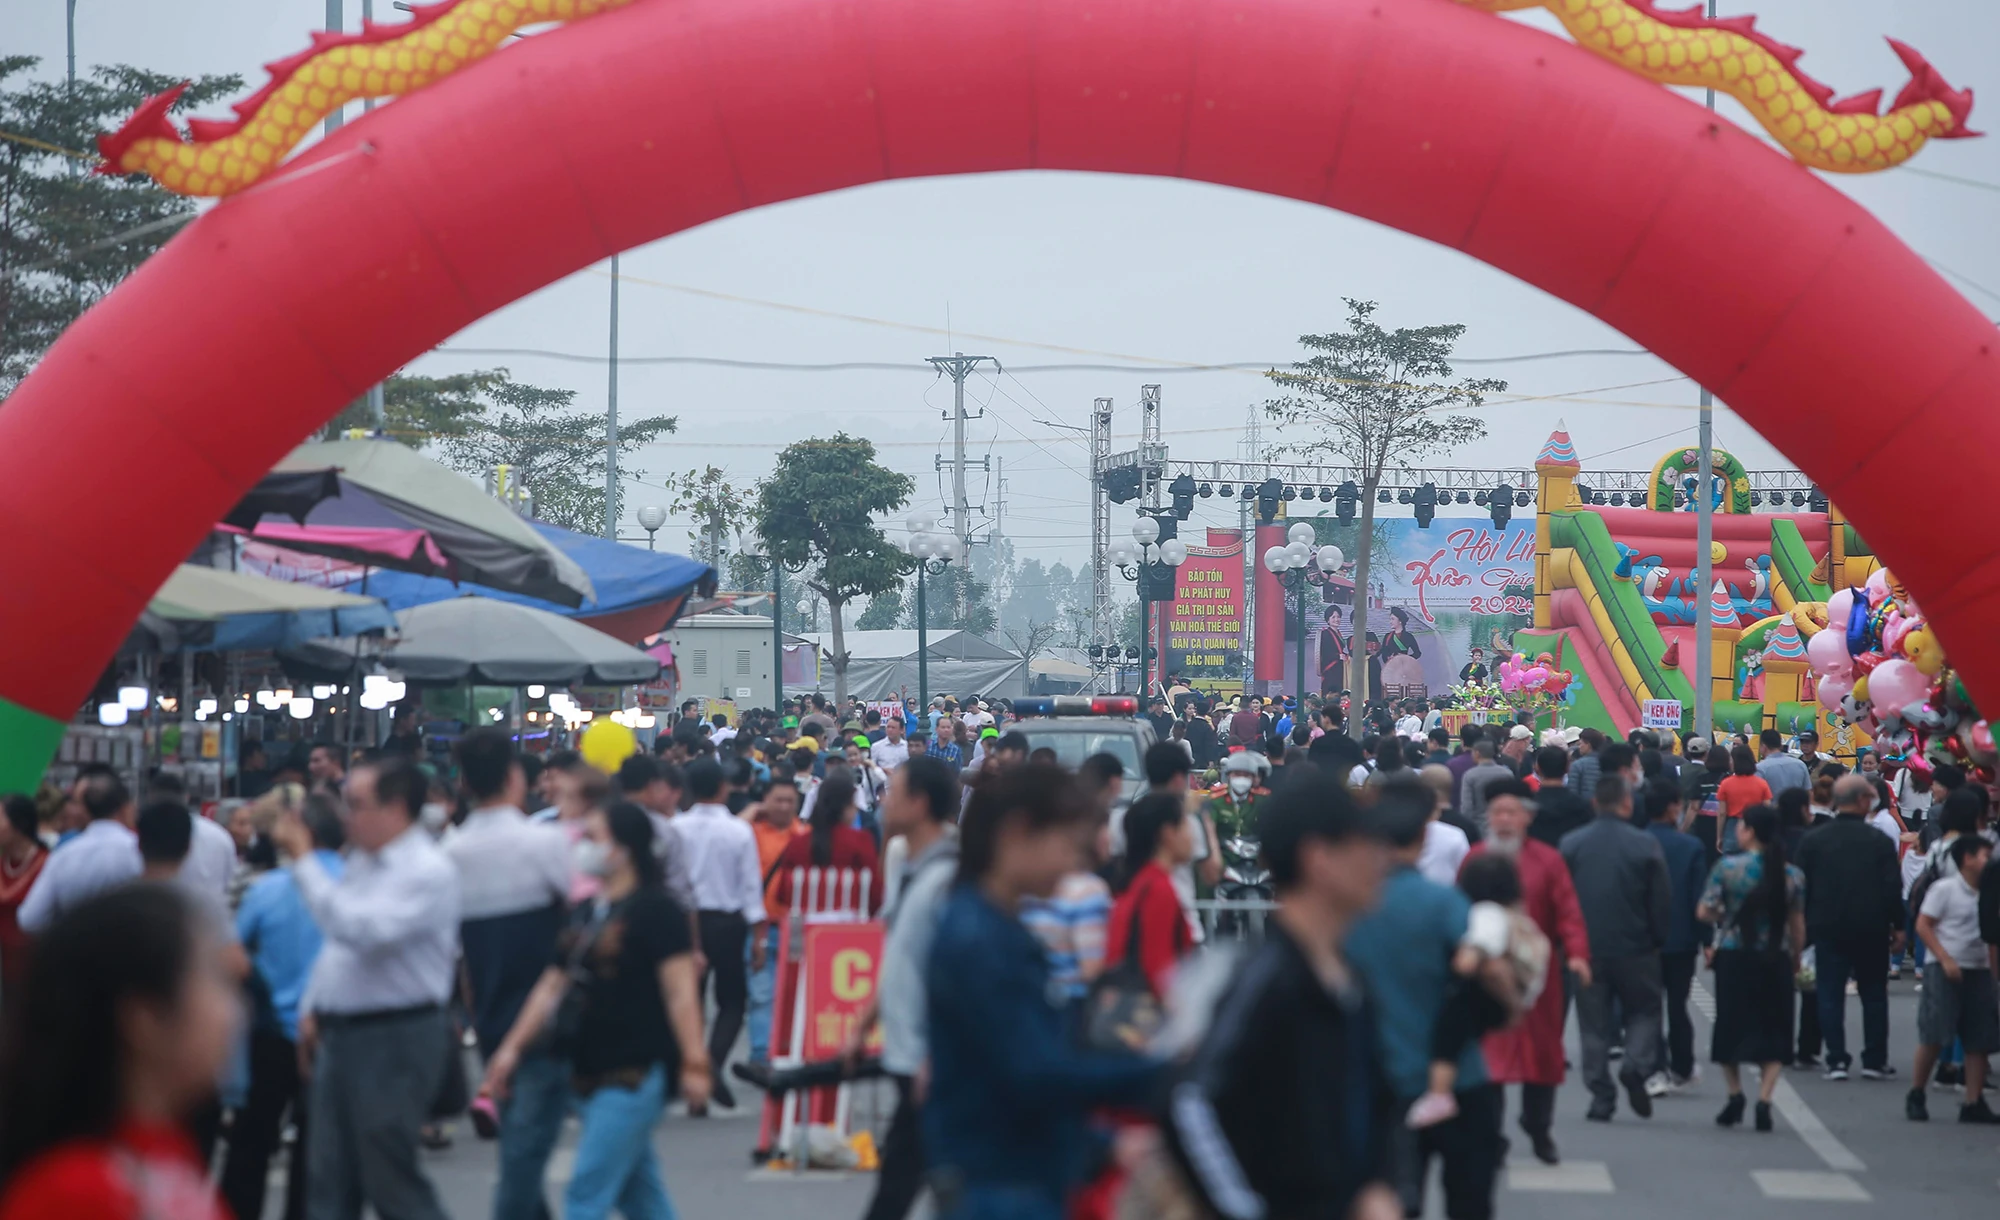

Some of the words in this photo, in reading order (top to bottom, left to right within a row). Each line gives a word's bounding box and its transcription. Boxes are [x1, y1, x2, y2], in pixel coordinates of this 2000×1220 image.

[1447, 528, 1505, 566] Hội
[1188, 567, 1204, 582] BẢO
[1180, 586, 1191, 599] VÀ
[1192, 586, 1213, 599] PHÁT
[1215, 588, 1231, 599] HUY
[1406, 549, 1473, 623] Xuân
[1481, 568, 1535, 591] Giáp
[1176, 602, 1190, 616] GIÁ
[1192, 604, 1205, 618] TRỊ
[1207, 605, 1215, 616] DI
[1217, 601, 1234, 616] SẢN
[1470, 596, 1533, 615] 2024
[1170, 619, 1187, 632] VĂN
[1188, 619, 1205, 632] HOÁ
[1207, 618, 1222, 632] THẾ
[1224, 619, 1240, 633] GIỚI
[1172, 636, 1189, 649] DÂN
[1191, 638, 1202, 649] CA
[1204, 638, 1225, 649] QUAN
[1227, 638, 1239, 652] HỌ
[1186, 651, 1203, 666] BẮC
[1204, 655, 1225, 666] NINH
